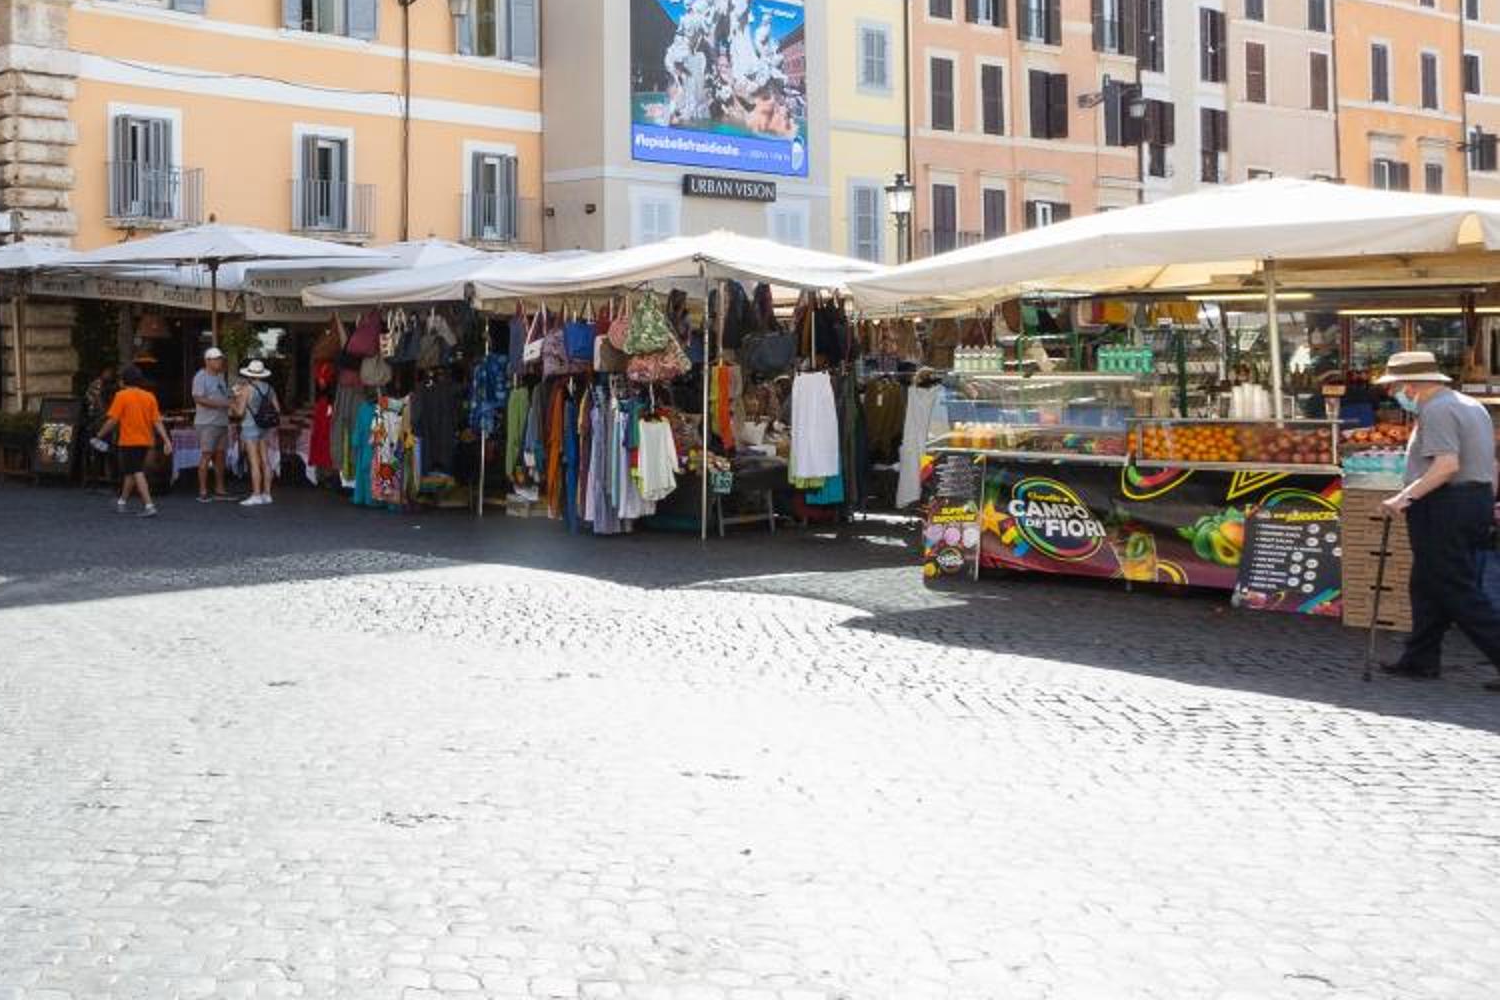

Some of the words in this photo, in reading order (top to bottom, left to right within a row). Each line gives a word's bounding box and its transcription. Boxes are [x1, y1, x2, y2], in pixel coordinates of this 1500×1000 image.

[690, 178, 733, 196] URBAN
[736, 183, 776, 199] VISION
[1008, 499, 1089, 519] CAMPO
[1045, 519, 1107, 537] FIORI
